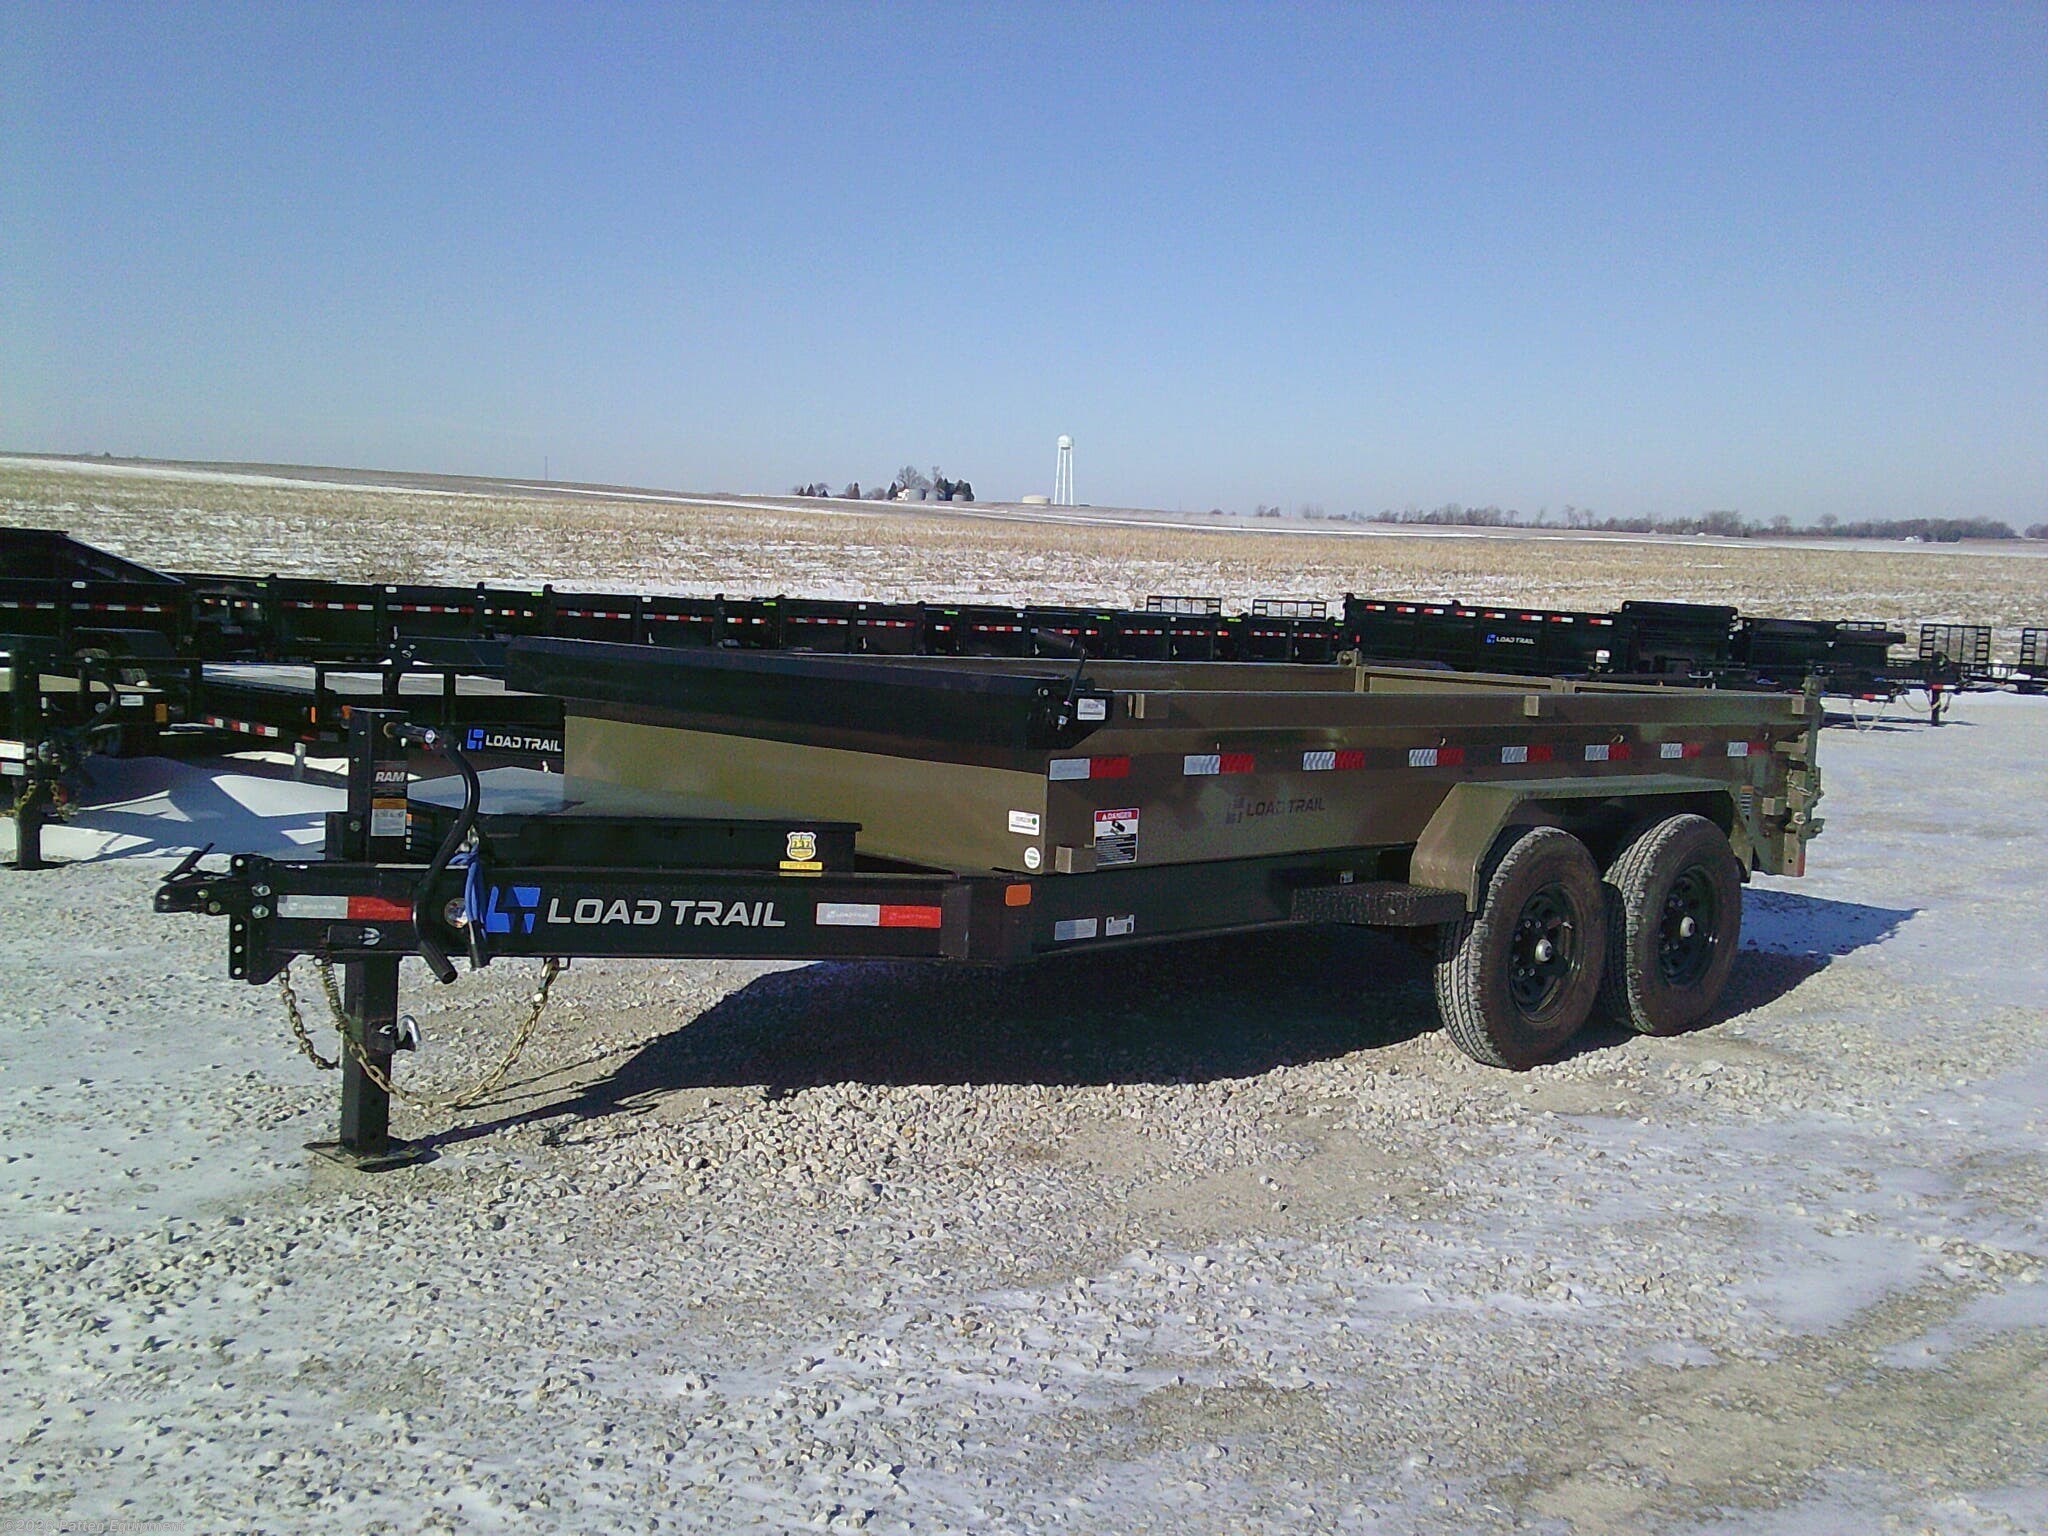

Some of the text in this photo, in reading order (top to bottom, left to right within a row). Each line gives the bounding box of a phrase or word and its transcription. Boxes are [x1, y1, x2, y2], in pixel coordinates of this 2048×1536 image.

[485, 734, 521, 749] LOAD
[523, 737, 563, 752] TRAIL
[375, 771, 405, 783] RAM
[1288, 798, 1325, 814] TRAIL
[547, 897, 664, 925] LOAD
[669, 900, 787, 927] TRAIL
